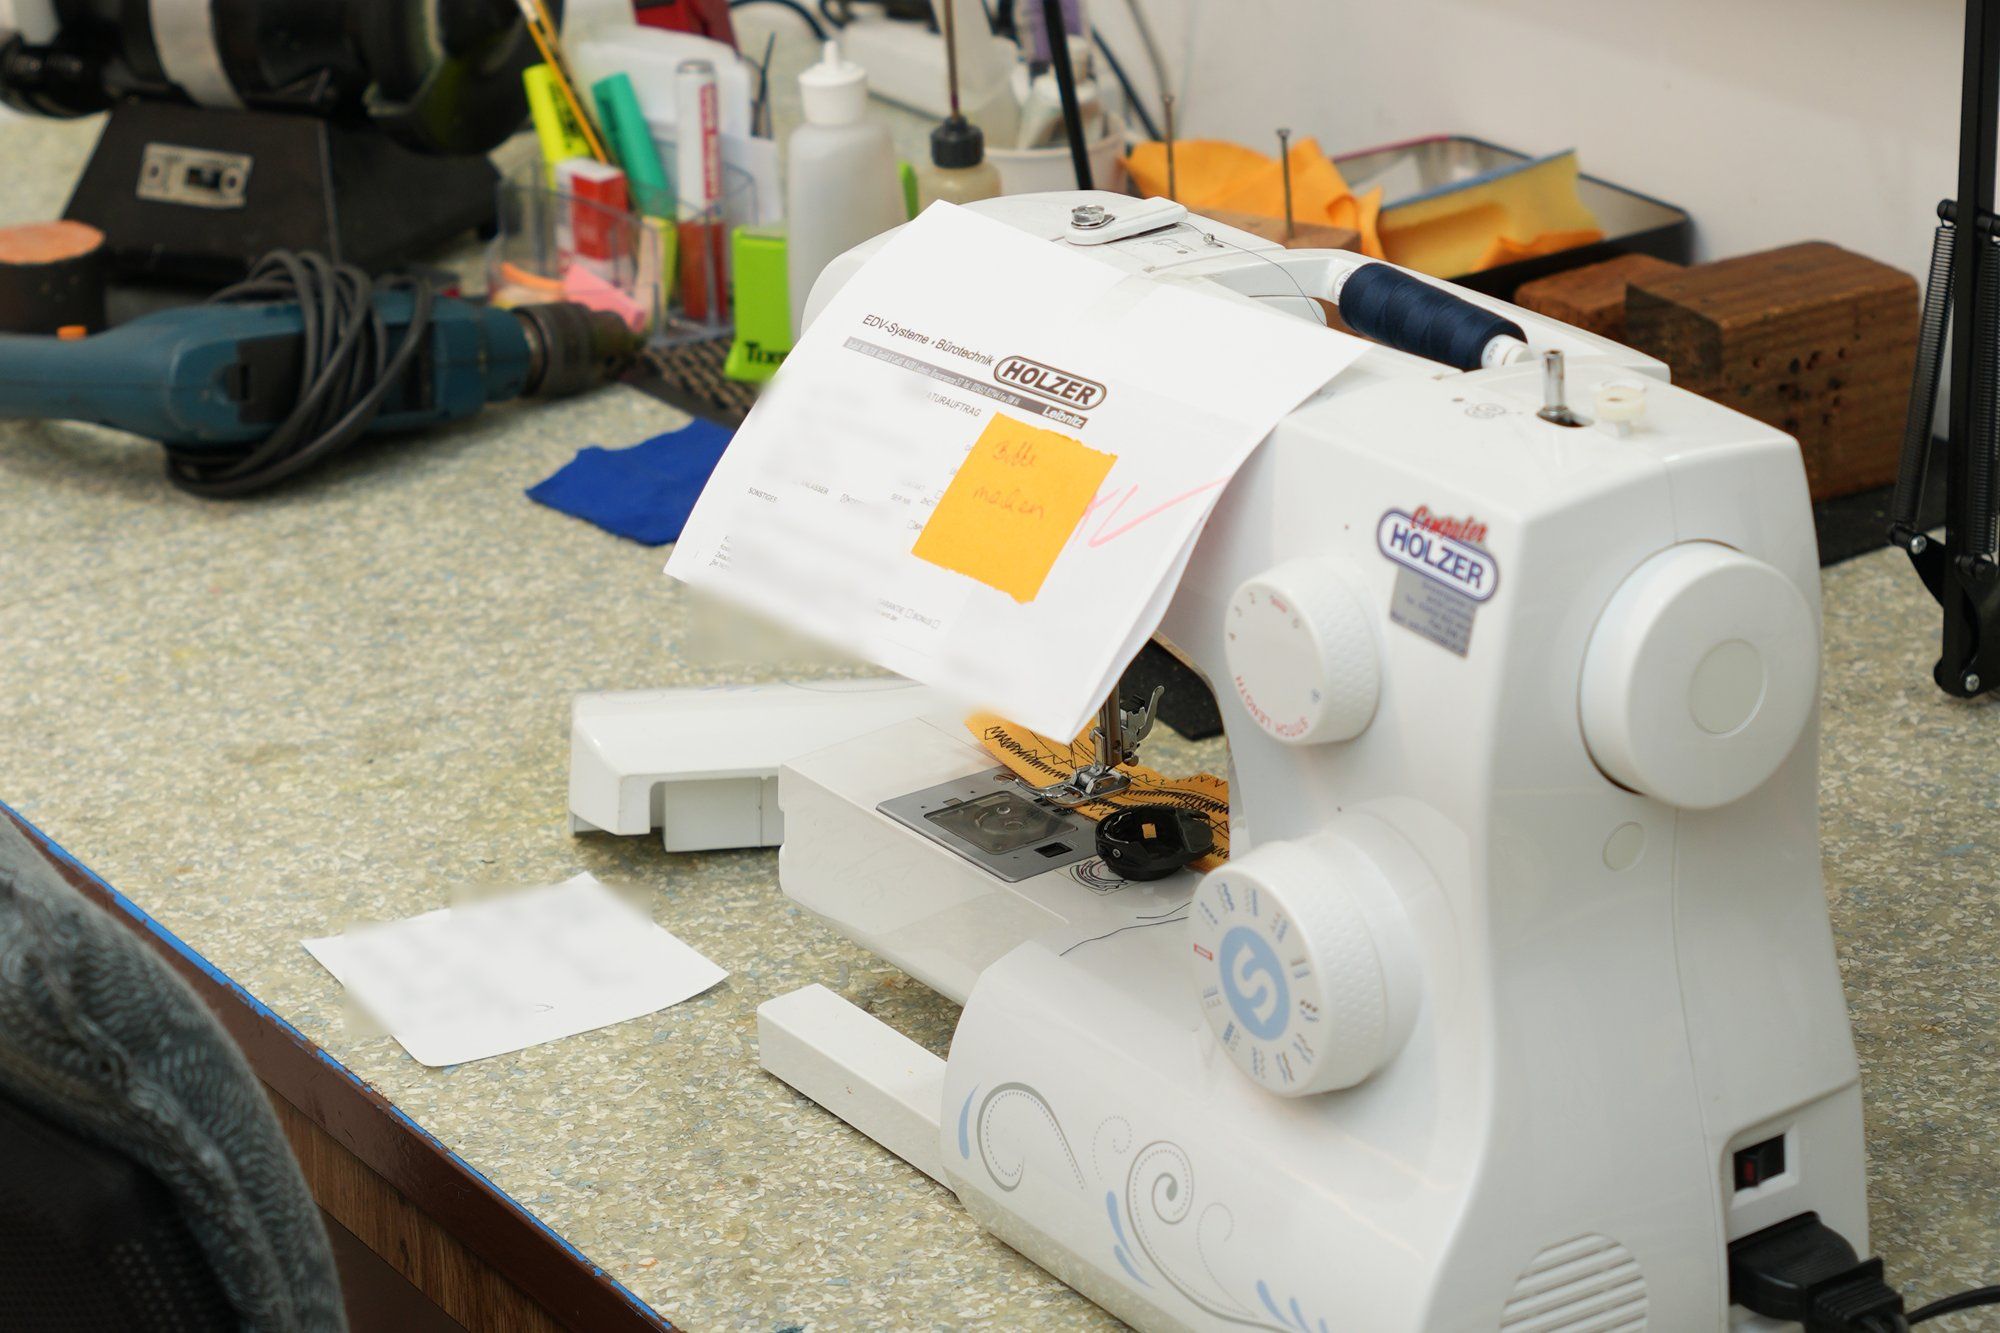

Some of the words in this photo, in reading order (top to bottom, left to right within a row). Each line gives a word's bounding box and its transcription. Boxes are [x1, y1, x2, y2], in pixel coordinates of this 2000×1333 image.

[862, 314, 930, 346] EDV-Systeme
[935, 338, 995, 367] Bürotechnik
[1002, 360, 1097, 405] HOLZER
[1042, 405, 1085, 427] Leibnitz
[1390, 523, 1484, 589] HOLZER
